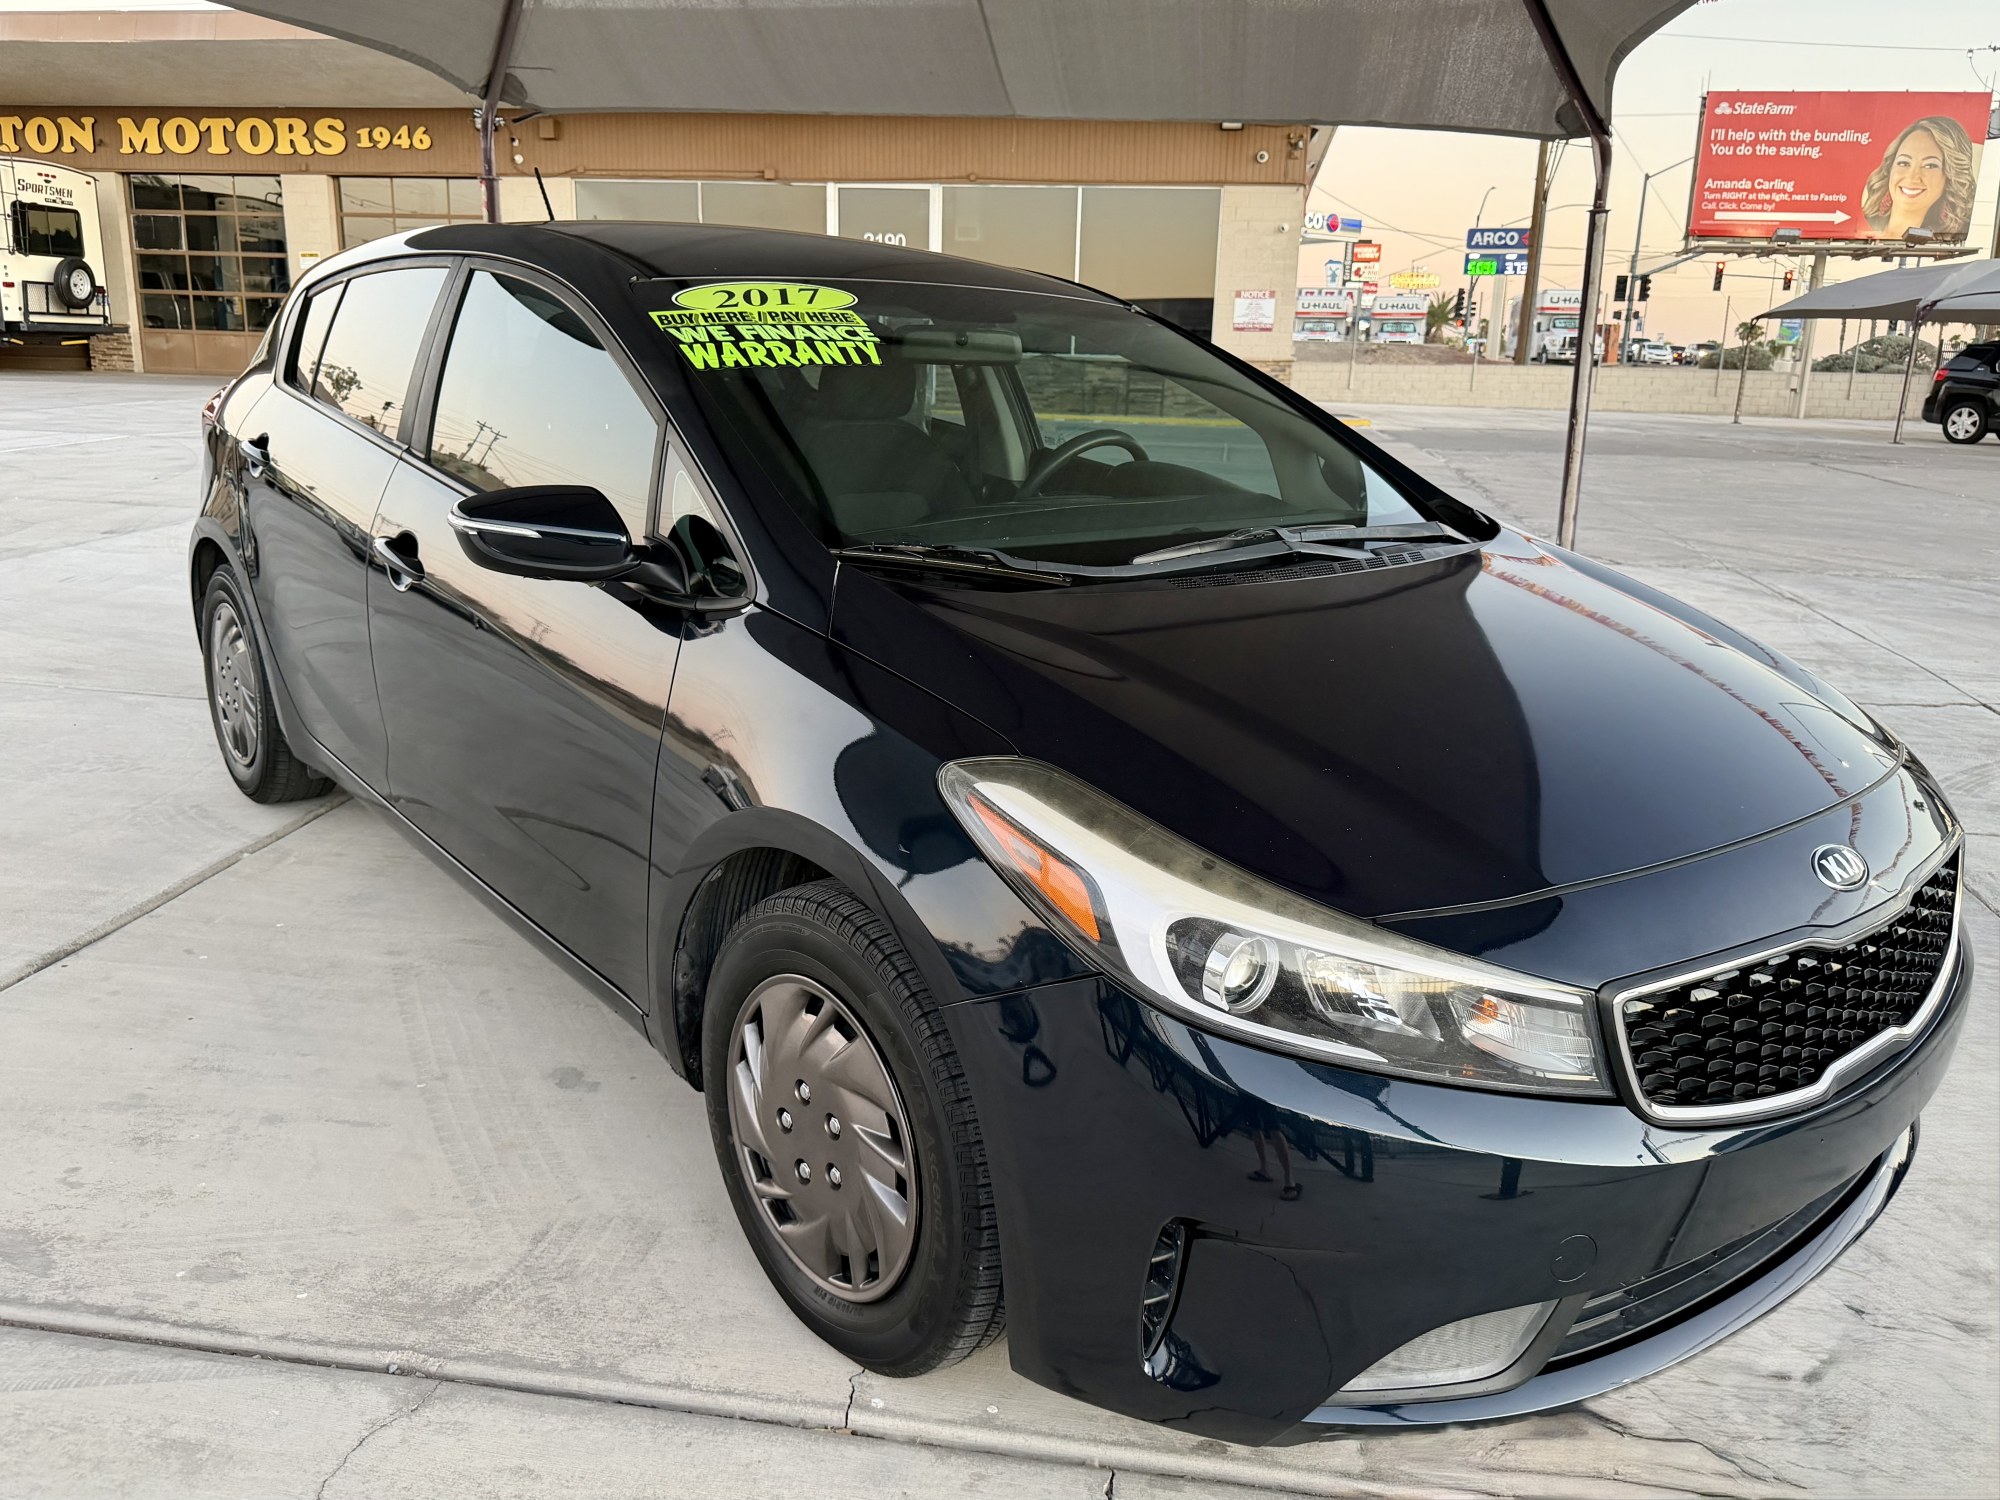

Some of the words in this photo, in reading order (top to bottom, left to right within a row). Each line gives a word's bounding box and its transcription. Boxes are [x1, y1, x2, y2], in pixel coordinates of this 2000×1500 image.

[117, 117, 347, 155] MOTORS
[356, 125, 432, 150] 1946
[1710, 129, 1725, 140] I'll
[1728, 129, 1755, 143] help
[1758, 129, 1787, 141] with
[1790, 129, 1811, 141] the
[1814, 129, 1872, 145] bundling.
[1710, 144, 1733, 156] You
[1736, 144, 1752, 155] do
[1755, 144, 1777, 156] the
[1779, 144, 1823, 159] saving.
[1704, 178, 1752, 189] Amanda
[1754, 178, 1795, 192] Carling
[1721, 192, 1748, 200] RIGHT
[1748, 192, 1756, 200] at
[1757, 192, 1771, 200] the
[1771, 192, 1790, 202] light,
[1792, 193, 1809, 201] next
[1819, 193, 1848, 203] Fastrip
[1718, 202, 1738, 210] Click.
[1740, 202, 1762, 210] Come
[1763, 202, 1775, 211] by!
[1470, 231, 1520, 246] ARCO
[712, 288, 819, 309] 2017
[1240, 290, 1271, 299] NOTICE
[1550, 296, 1580, 304] U-HA
[1301, 302, 1342, 310] U-HAUL
[657, 313, 697, 326] BUY
[700, 311, 755, 324] HERE
[767, 311, 802, 323] PAY
[806, 311, 856, 324] HERE
[664, 325, 736, 343] WE
[734, 324, 881, 342] FINANCE
[679, 340, 882, 370] WARRANTY
